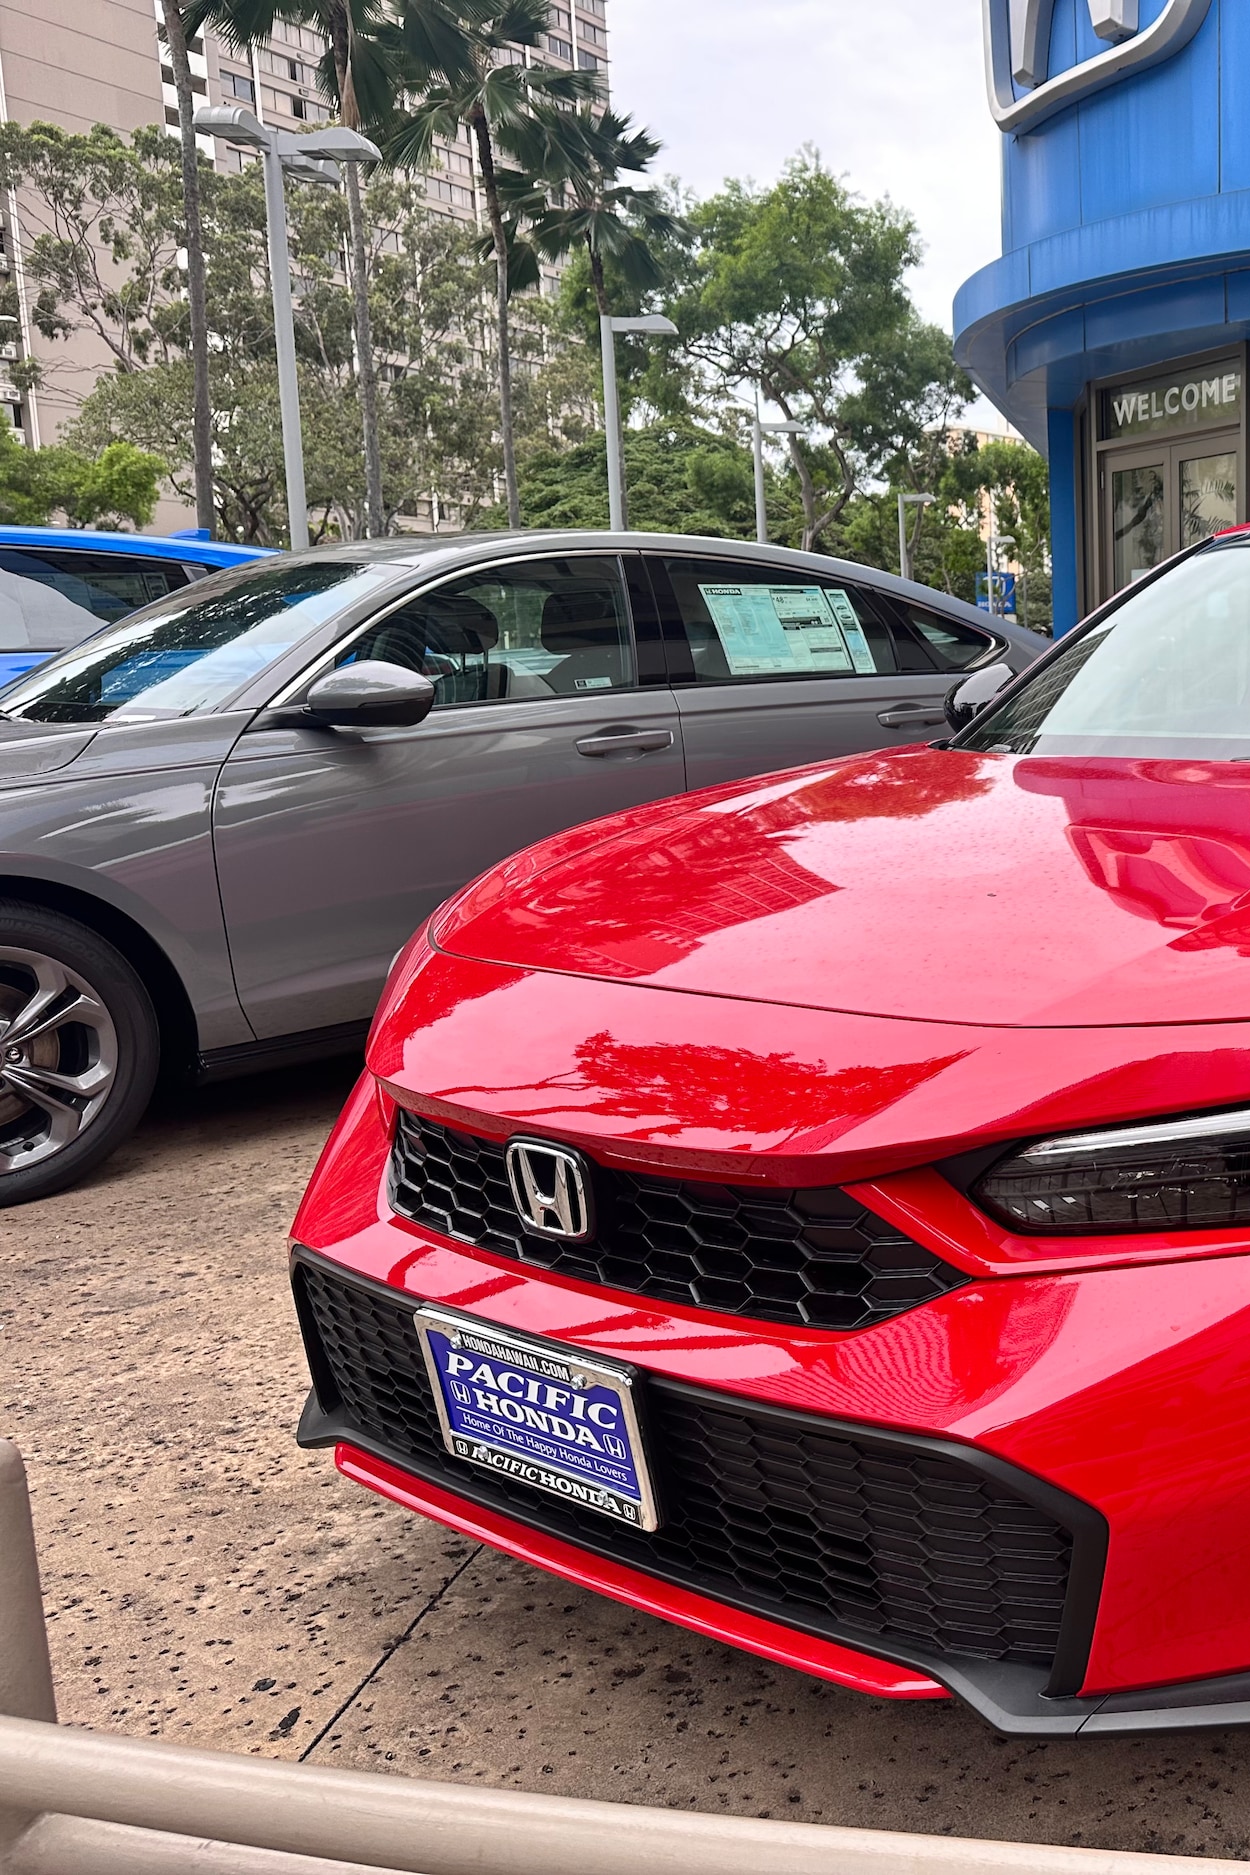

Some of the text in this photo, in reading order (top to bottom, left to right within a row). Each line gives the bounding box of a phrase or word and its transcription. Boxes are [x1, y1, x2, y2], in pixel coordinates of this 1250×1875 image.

[1113, 373, 1236, 426] WELCOME
[445, 1350, 618, 1430] PACIFIC
[461, 1333, 570, 1382] HONDAHAWAII.COM
[462, 1412, 628, 1482] Home Of The Happy Honda Lovers
[471, 1387, 606, 1453] HONDA
